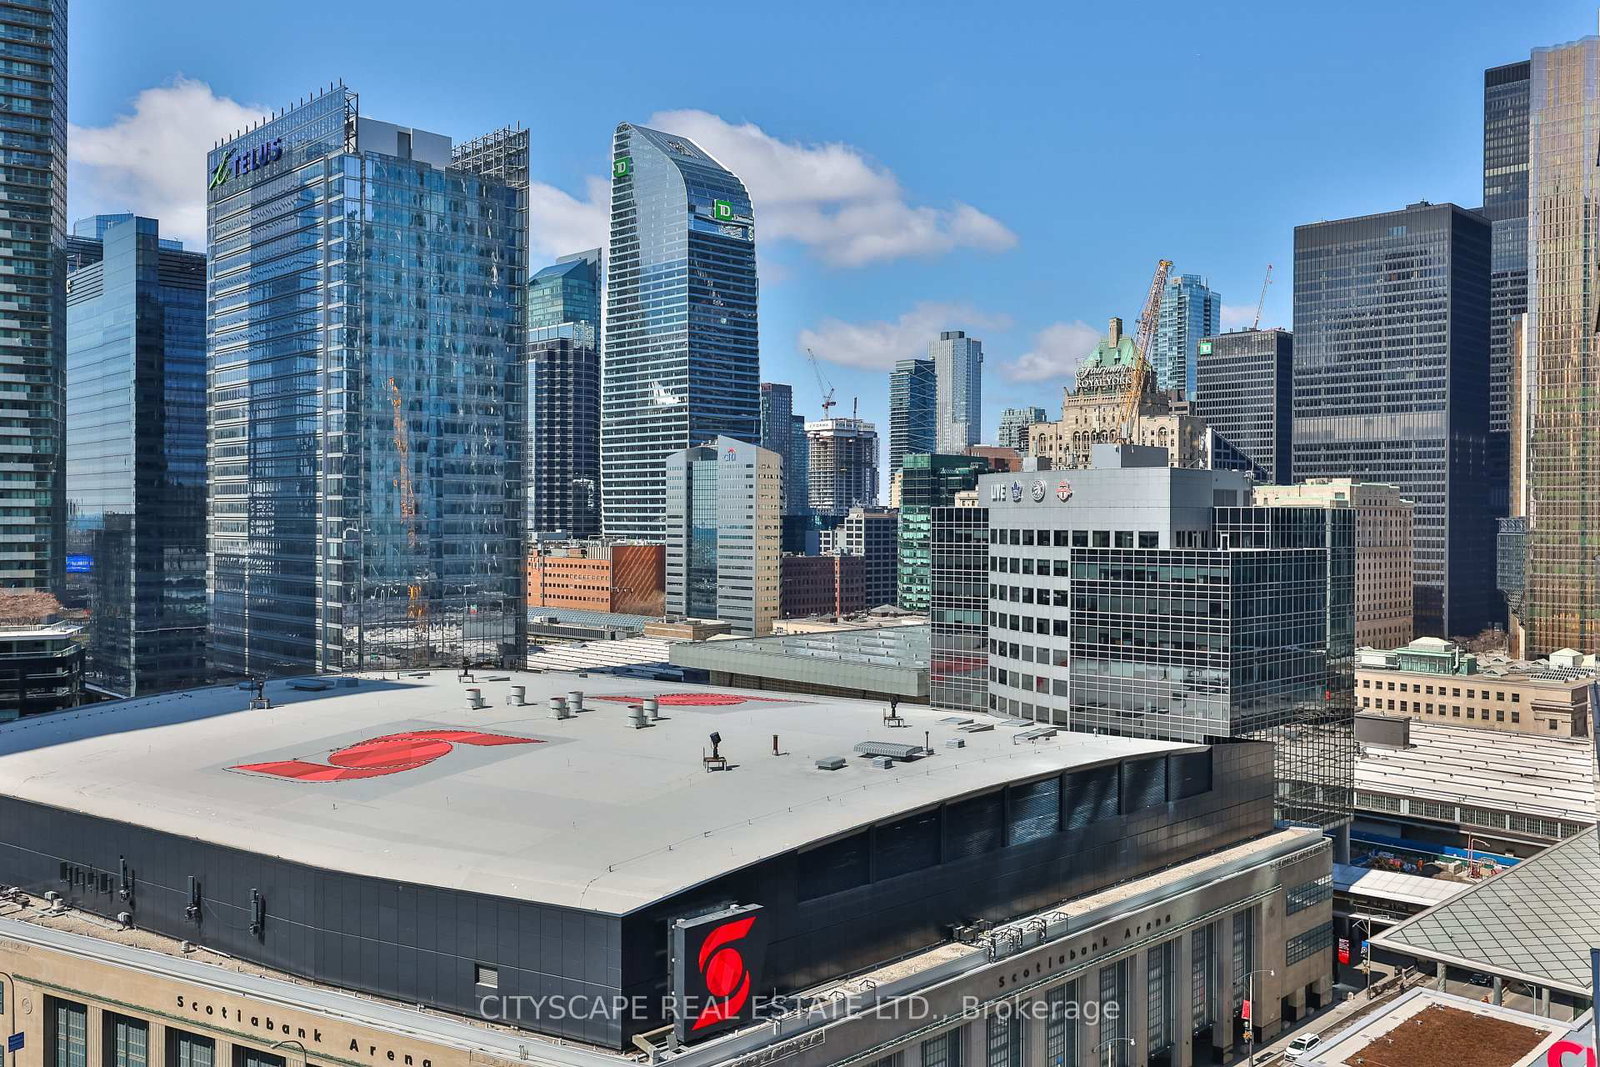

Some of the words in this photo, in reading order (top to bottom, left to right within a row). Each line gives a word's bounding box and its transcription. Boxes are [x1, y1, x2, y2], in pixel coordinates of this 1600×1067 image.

[235, 137, 284, 179] TELUS
[717, 203, 731, 217] TD
[1075, 376, 1104, 388] ROYAL
[998, 936, 1109, 988] Scotiabank
[1123, 913, 1172, 940] Arena
[177, 995, 322, 1043] Scotiabank
[349, 1038, 432, 1067] Arena
